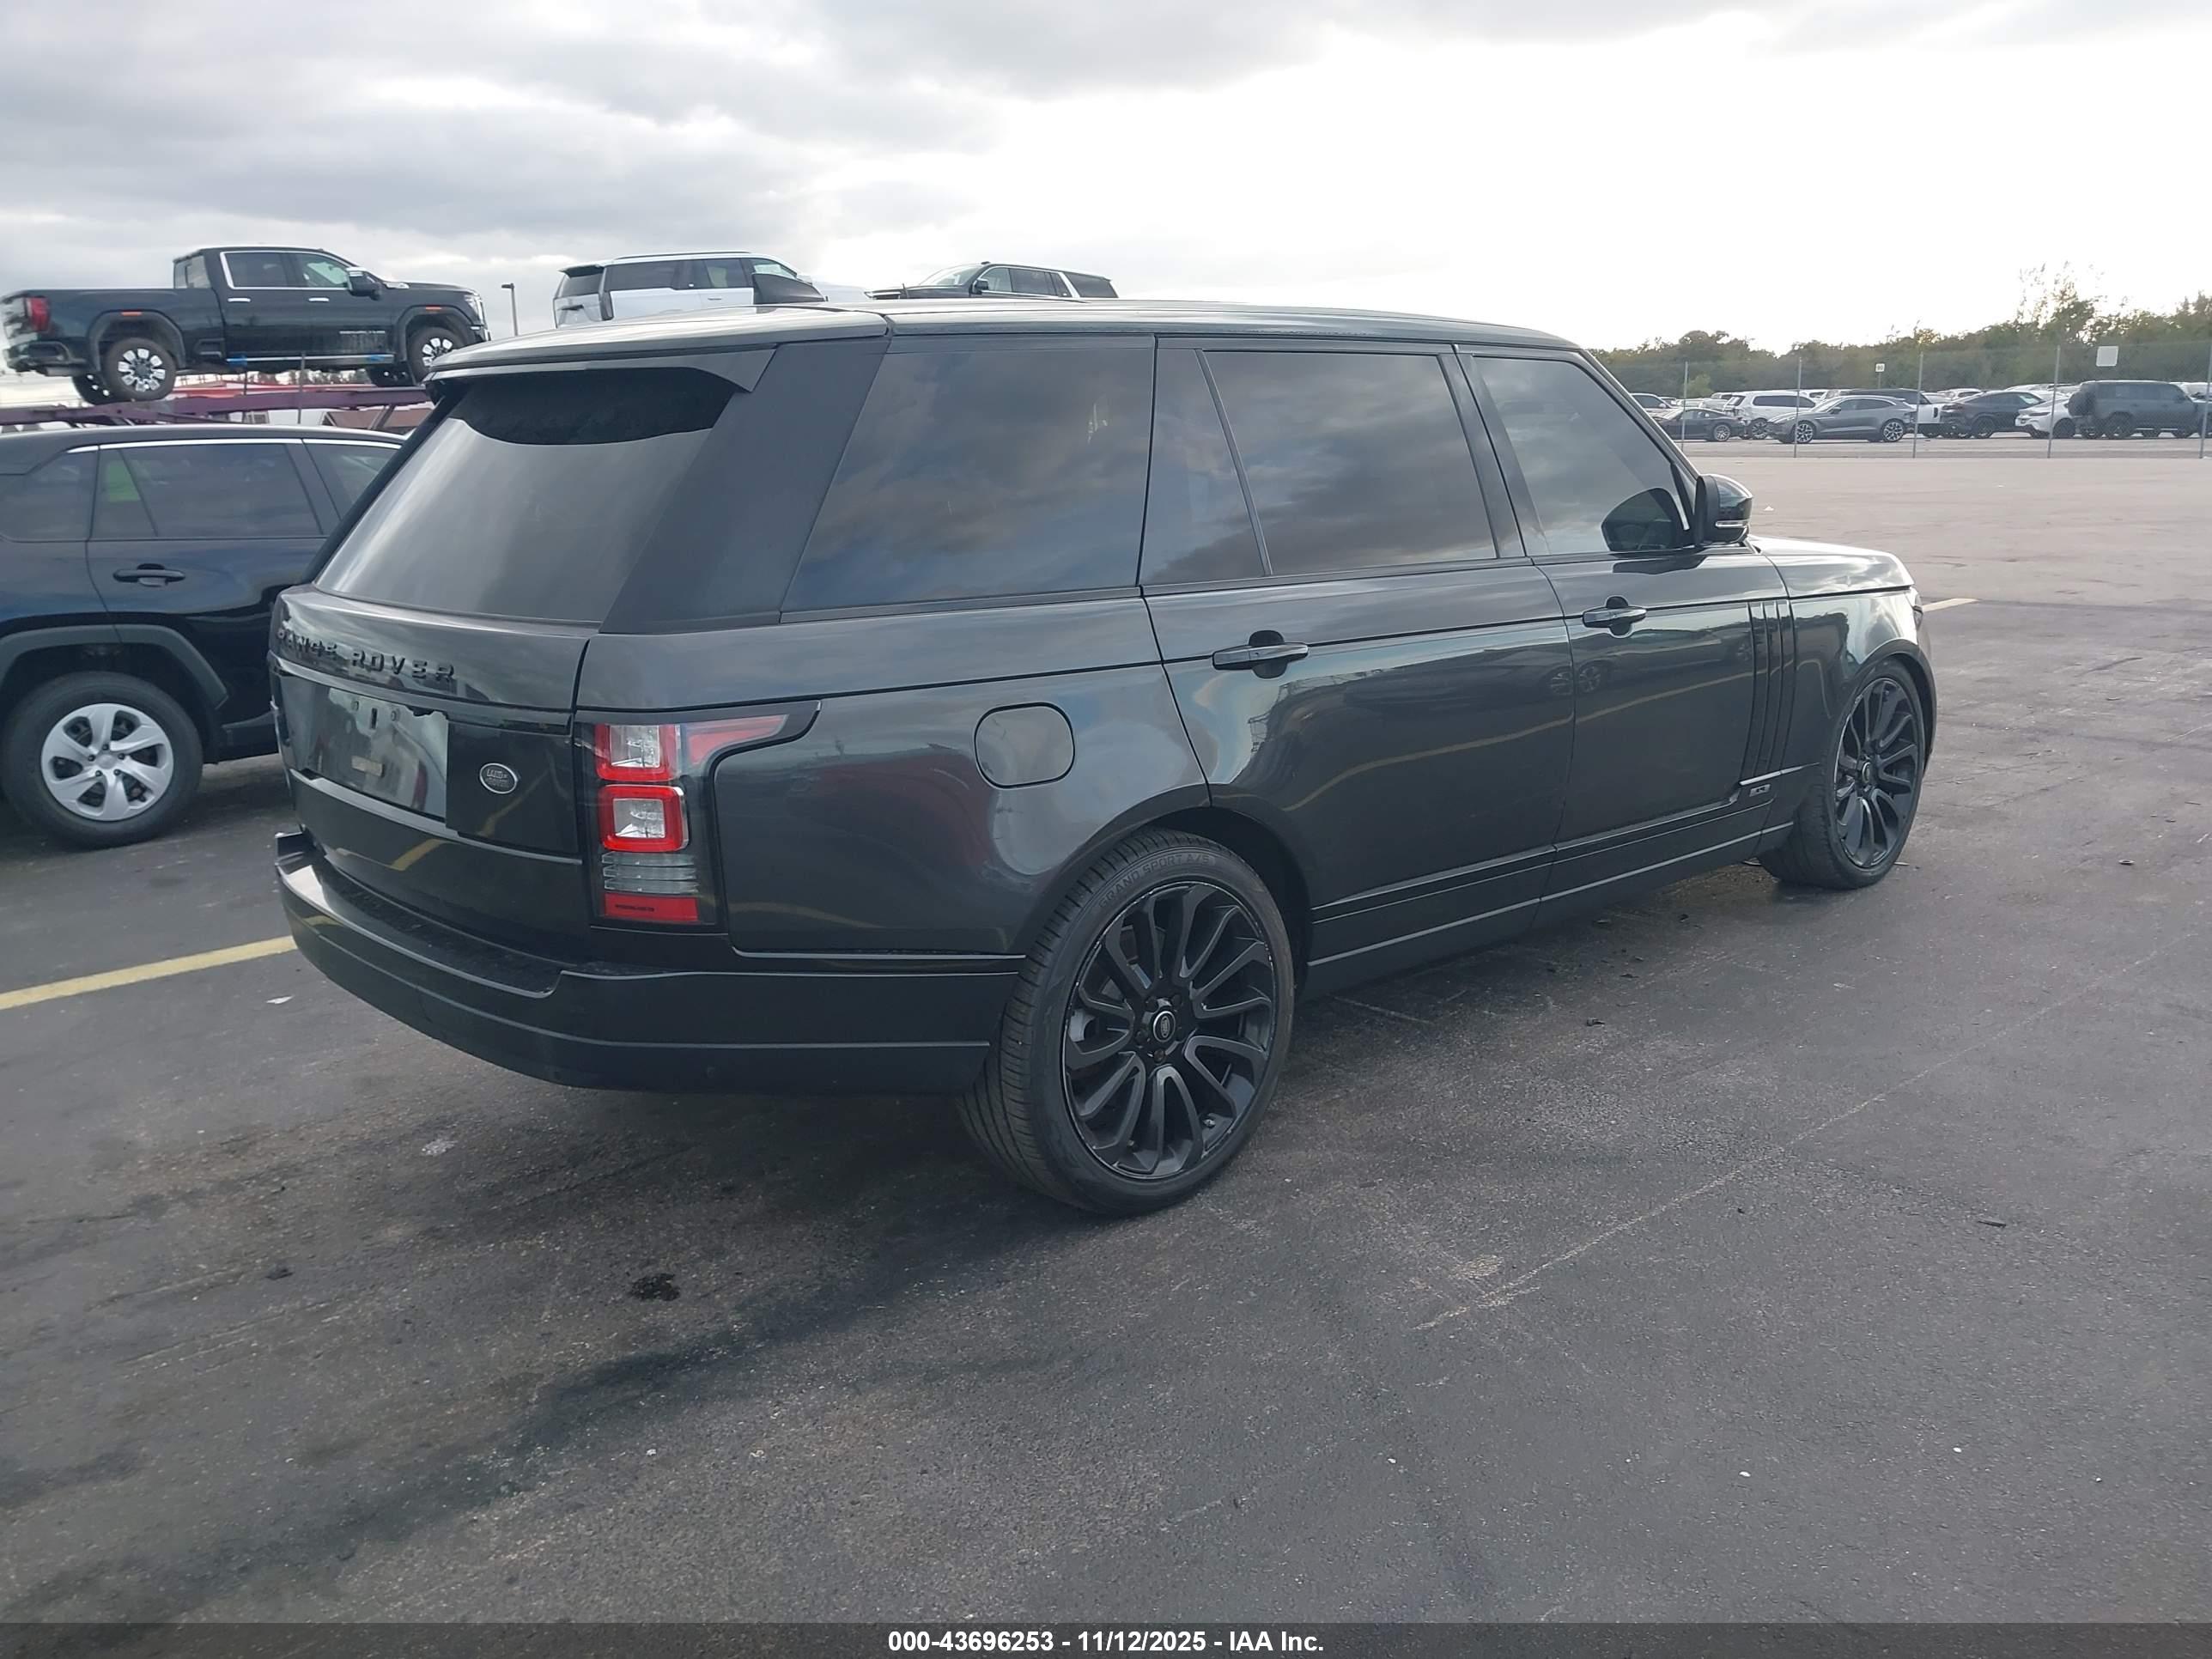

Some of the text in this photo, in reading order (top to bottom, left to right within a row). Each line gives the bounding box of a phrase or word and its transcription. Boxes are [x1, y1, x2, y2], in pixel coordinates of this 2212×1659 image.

[350, 649, 455, 681] ROVER
[1098, 853, 1210, 908] GRAND SPORT A/S
